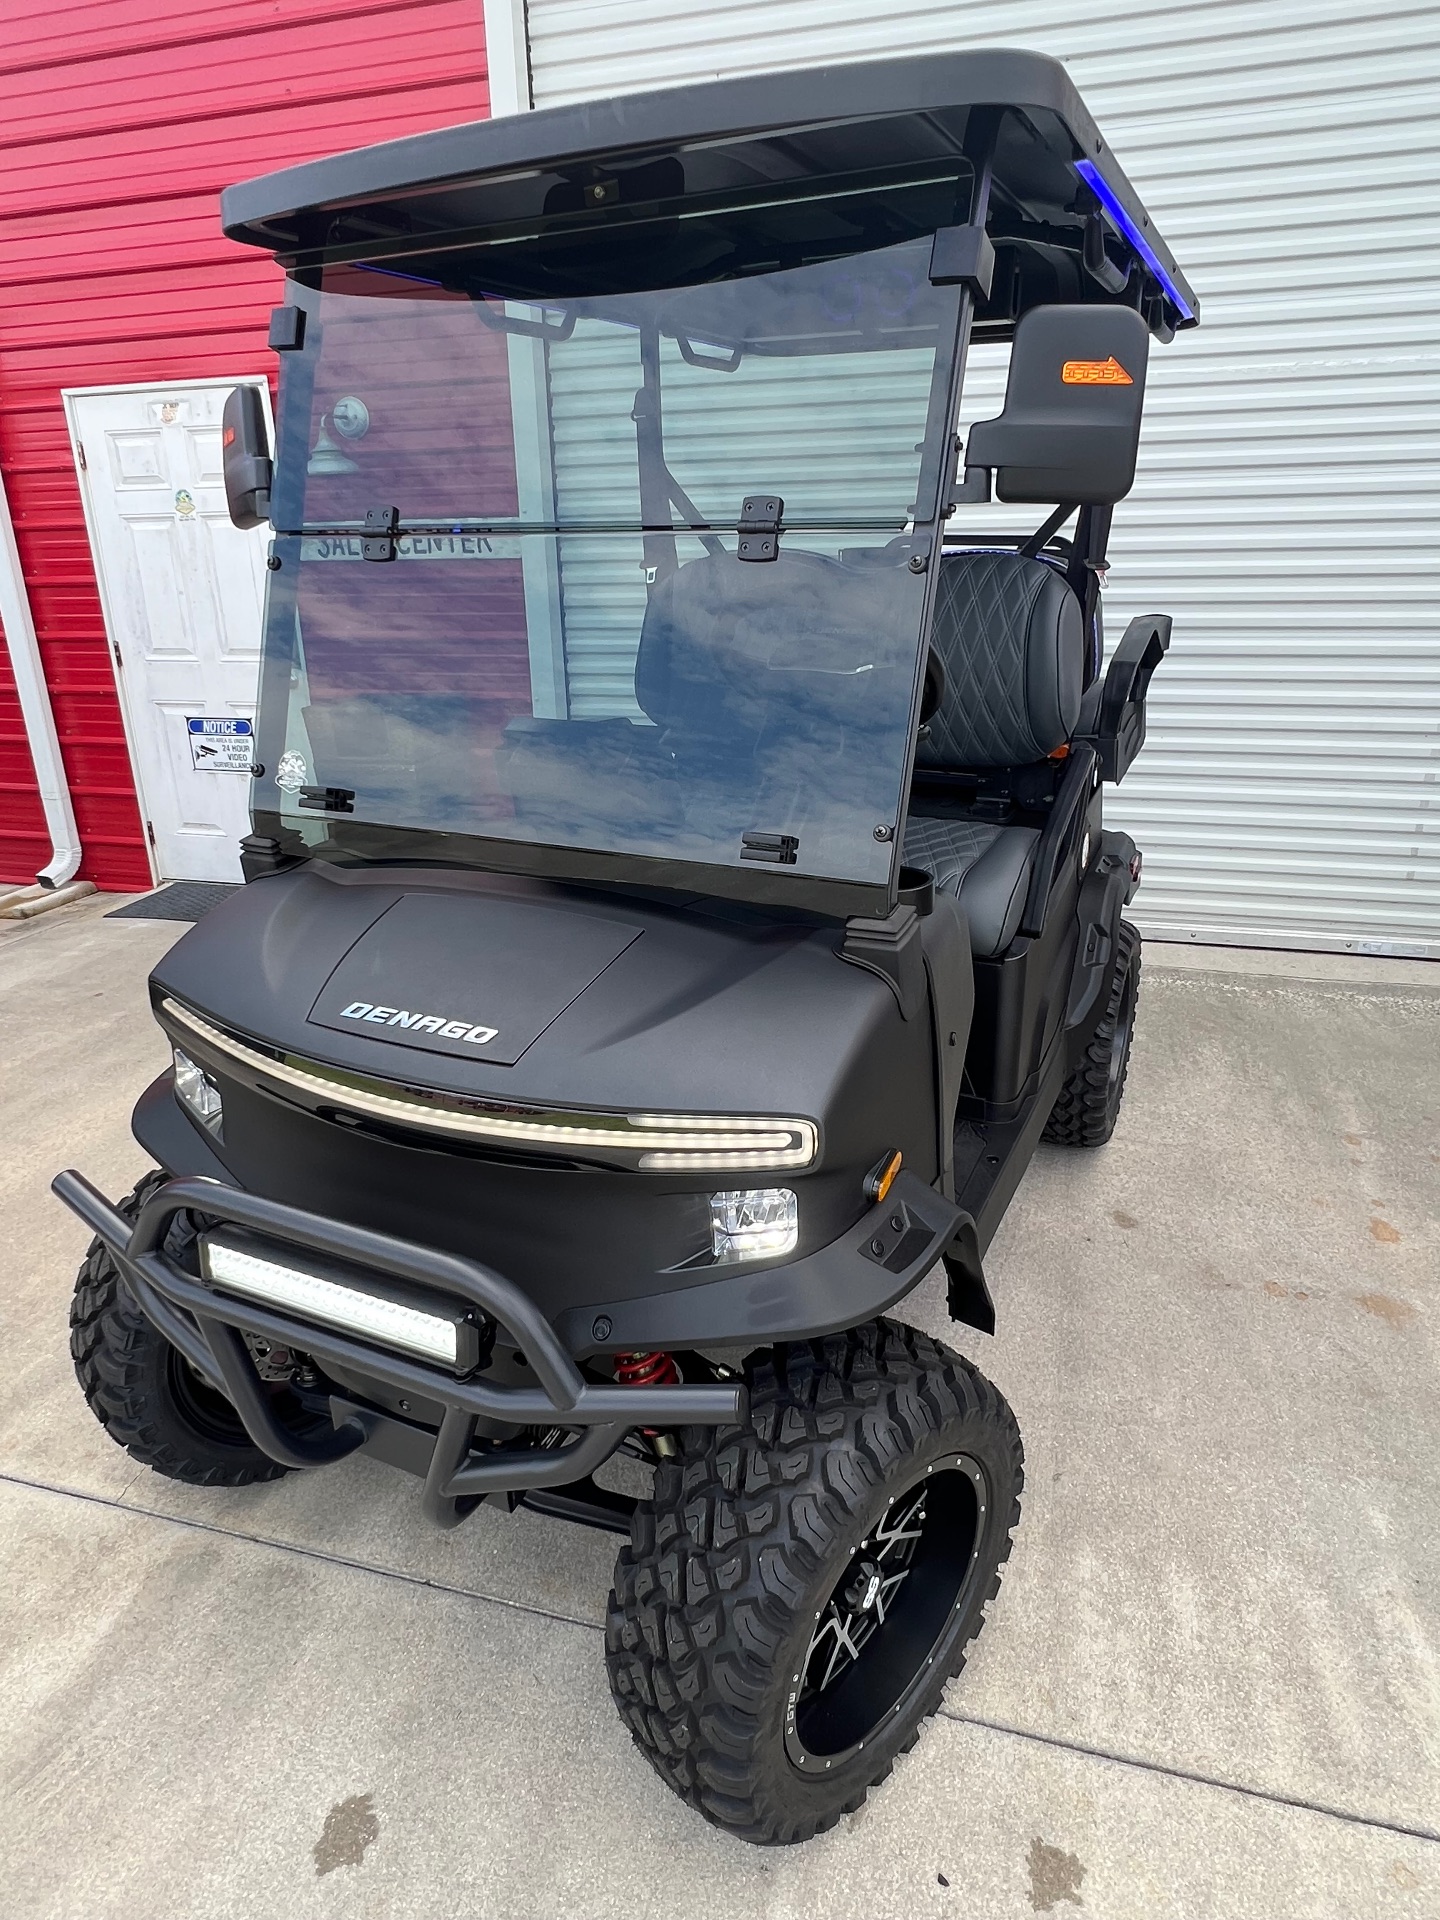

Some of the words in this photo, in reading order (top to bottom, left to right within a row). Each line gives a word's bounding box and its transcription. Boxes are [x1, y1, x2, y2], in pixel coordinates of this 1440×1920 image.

[397, 537, 493, 555] CENTER
[203, 720, 237, 734] NOTICE
[221, 744, 231, 752] 24
[231, 745, 250, 753] HOUR
[227, 753, 248, 762] VIDEO
[339, 1001, 499, 1045] DENAGO
[786, 1692, 796, 1722] GTW
